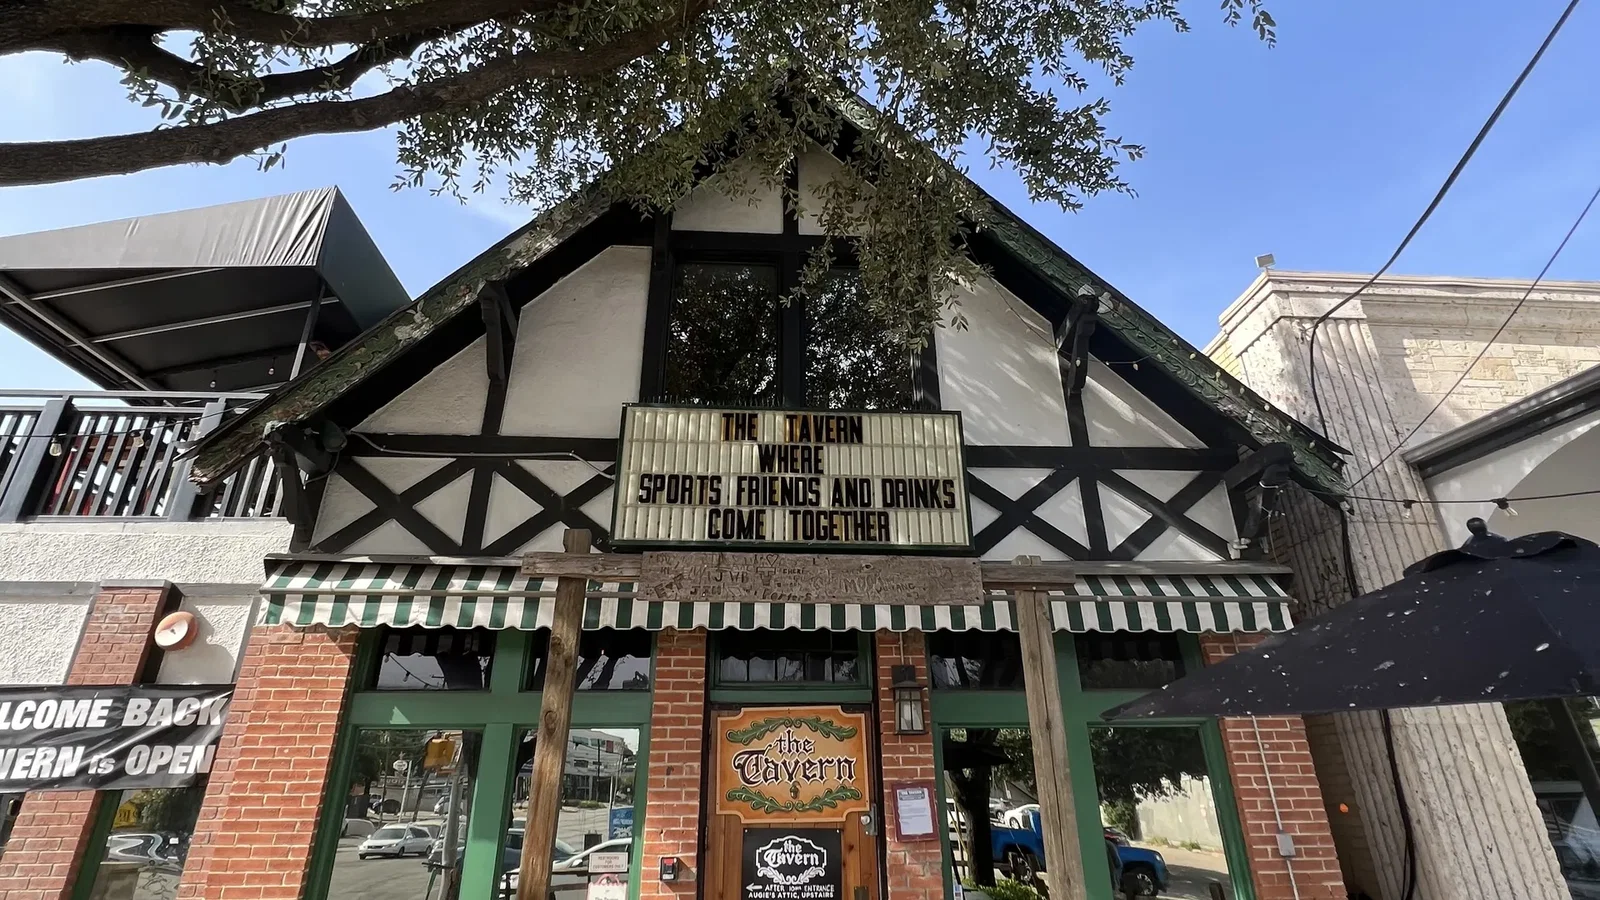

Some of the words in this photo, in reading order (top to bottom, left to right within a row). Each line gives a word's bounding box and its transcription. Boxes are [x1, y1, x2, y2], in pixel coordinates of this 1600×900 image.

[722, 413, 758, 441] THE
[786, 414, 863, 444] TAVERN
[758, 444, 824, 474] WHERE
[638, 473, 722, 504] SPORTS
[736, 476, 821, 507] FRIENDS
[831, 478, 872, 508] AND
[881, 478, 956, 509] DRINKS
[708, 508, 766, 540] COME
[789, 509, 890, 542] TOGETHER
[121, 697, 228, 727] BACK
[775, 727, 816, 756] the
[125, 745, 216, 775] OPEN
[732, 744, 857, 786] Tavern
[763, 847, 820, 868] Tavern
[783, 839, 803, 854] the
[748, 891, 776, 899] AUGIE'S
[801, 891, 834, 899] UPSTAIRS
[764, 884, 785, 892] AFTER
[804, 883, 835, 892] ENTRANCE
